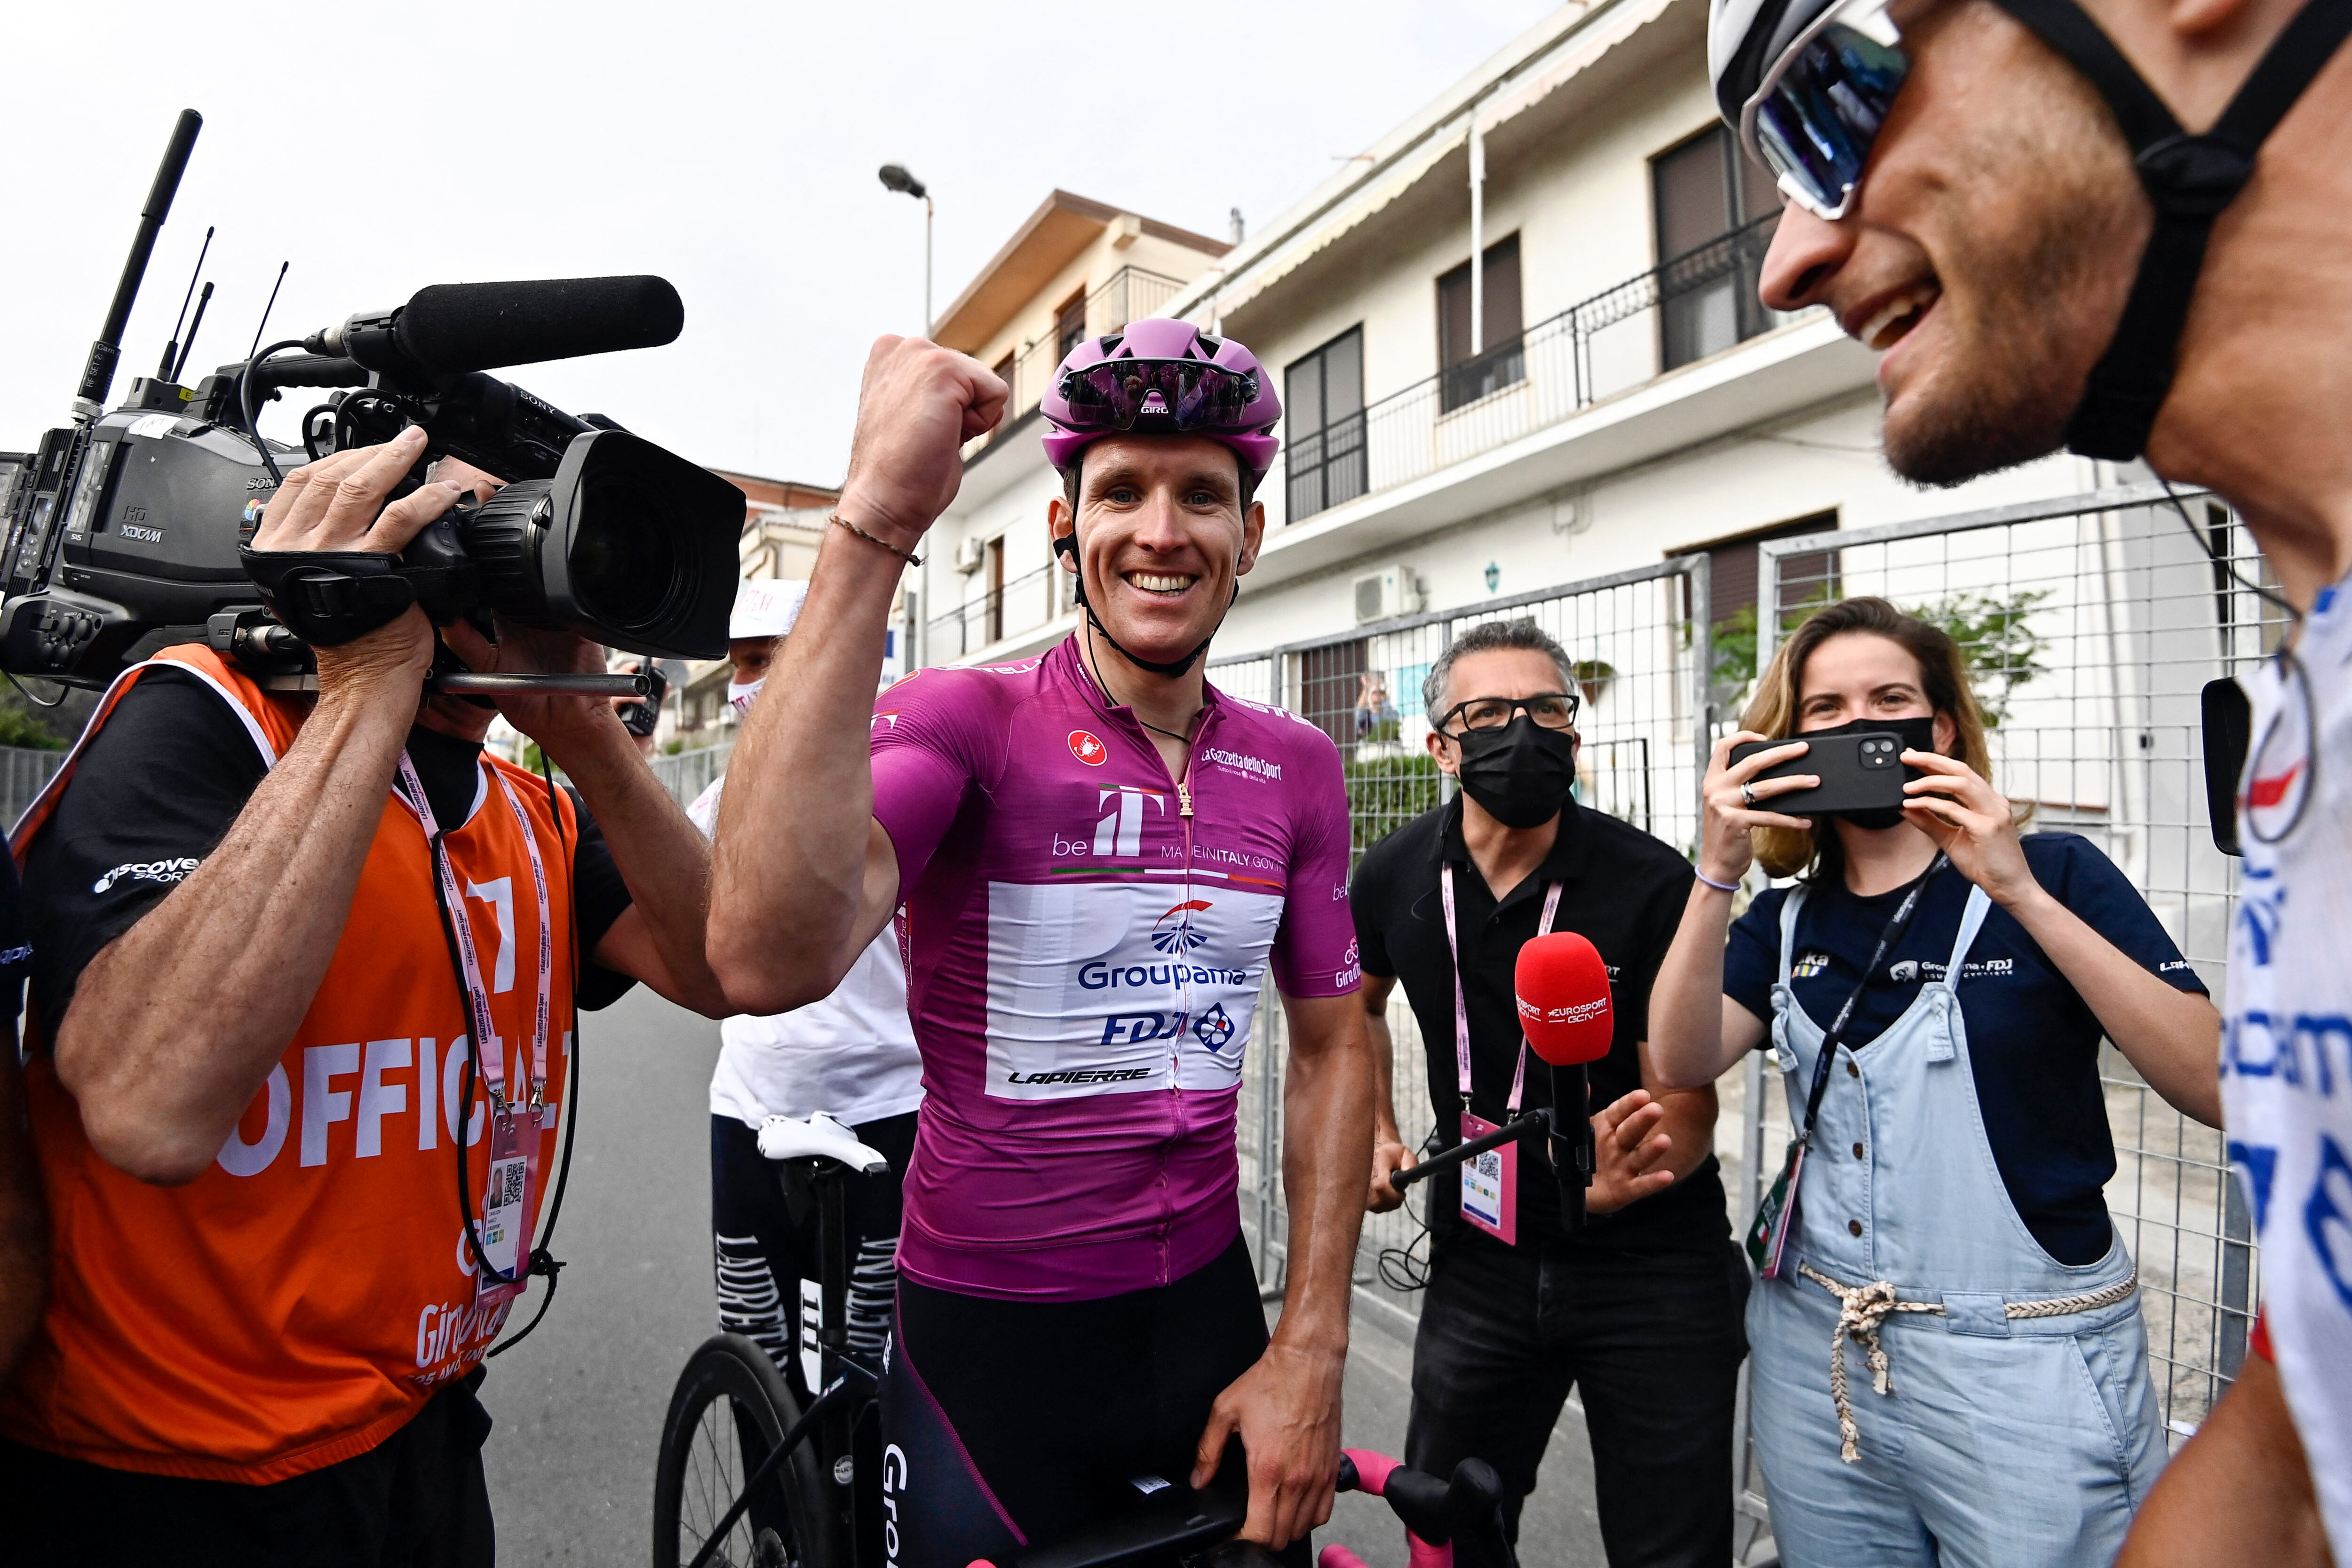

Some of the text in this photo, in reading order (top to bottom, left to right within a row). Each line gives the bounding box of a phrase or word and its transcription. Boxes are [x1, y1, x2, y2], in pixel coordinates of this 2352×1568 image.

[97, 344, 115, 354] Cam
[90, 362, 100, 376] SET
[87, 378, 94, 387] RF
[520, 390, 556, 414] SONY
[247, 478, 285, 490] SON
[124, 506, 147, 521] HD
[121, 525, 163, 543] XDCAM
[1201, 748, 1282, 781] La Gazzetta dello Sport
[1052, 833, 1088, 856] be
[463, 936, 472, 959] Gazzetta
[1922, 959, 2013, 971] Grouma FDJ
[1078, 962, 1247, 990] Groupama
[1550, 997, 1606, 1017] EUROSPORT
[477, 1014, 486, 1038] Gazzetta
[1568, 1011, 1594, 1023] GCN
[1100, 1011, 1190, 1045] FDJ
[1008, 1068, 1151, 1084] LAPIERRE
